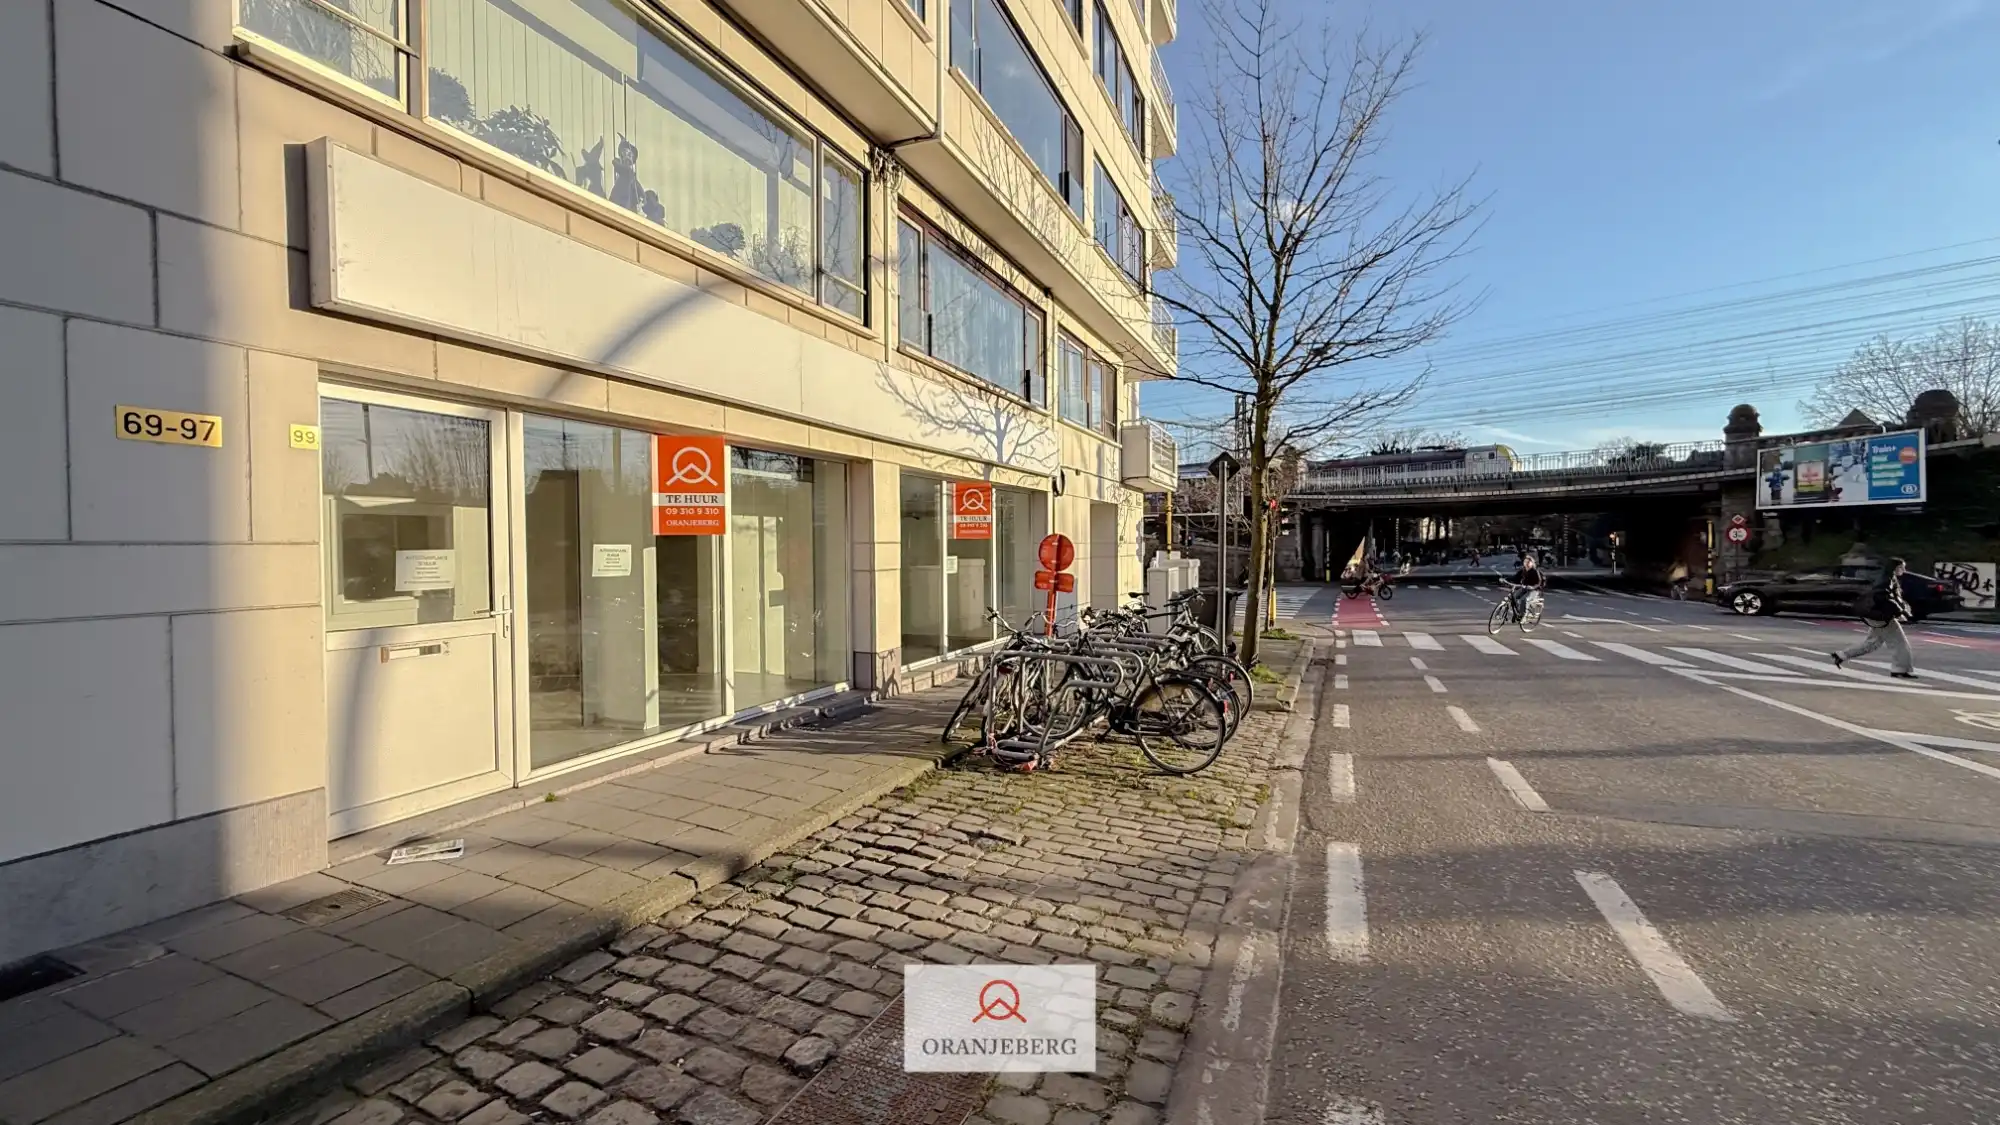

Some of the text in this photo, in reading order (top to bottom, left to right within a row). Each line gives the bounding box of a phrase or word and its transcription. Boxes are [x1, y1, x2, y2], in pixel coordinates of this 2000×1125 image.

[123, 411, 216, 442] 69-97
[293, 429, 316, 444] 99
[666, 495, 719, 503] TE HUUR
